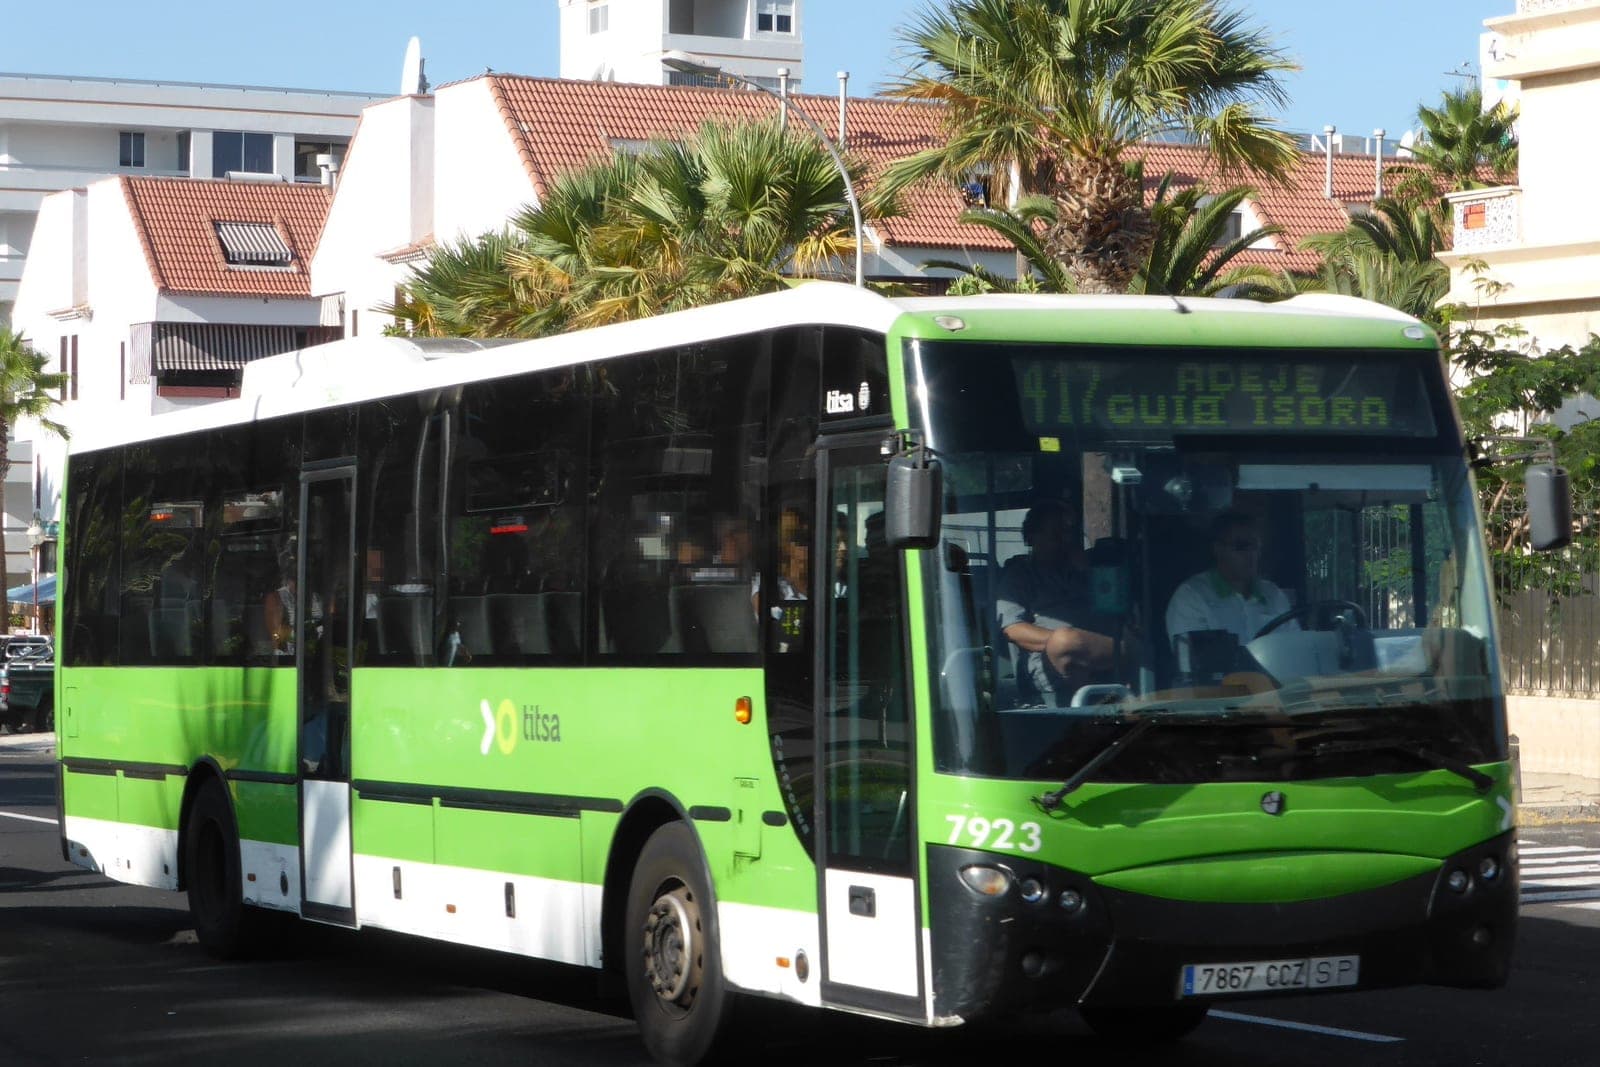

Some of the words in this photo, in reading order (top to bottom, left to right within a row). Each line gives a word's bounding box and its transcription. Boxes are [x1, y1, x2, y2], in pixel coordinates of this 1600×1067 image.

[1176, 363, 1320, 391] ADEJE
[827, 390, 854, 414] titsa
[1022, 361, 1101, 424] 417
[1252, 396, 1391, 426] ISORA
[522, 704, 561, 742] titsa
[945, 814, 1042, 853] 7923
[1202, 966, 1255, 990] 7867
[1266, 962, 1305, 987] CCZ
